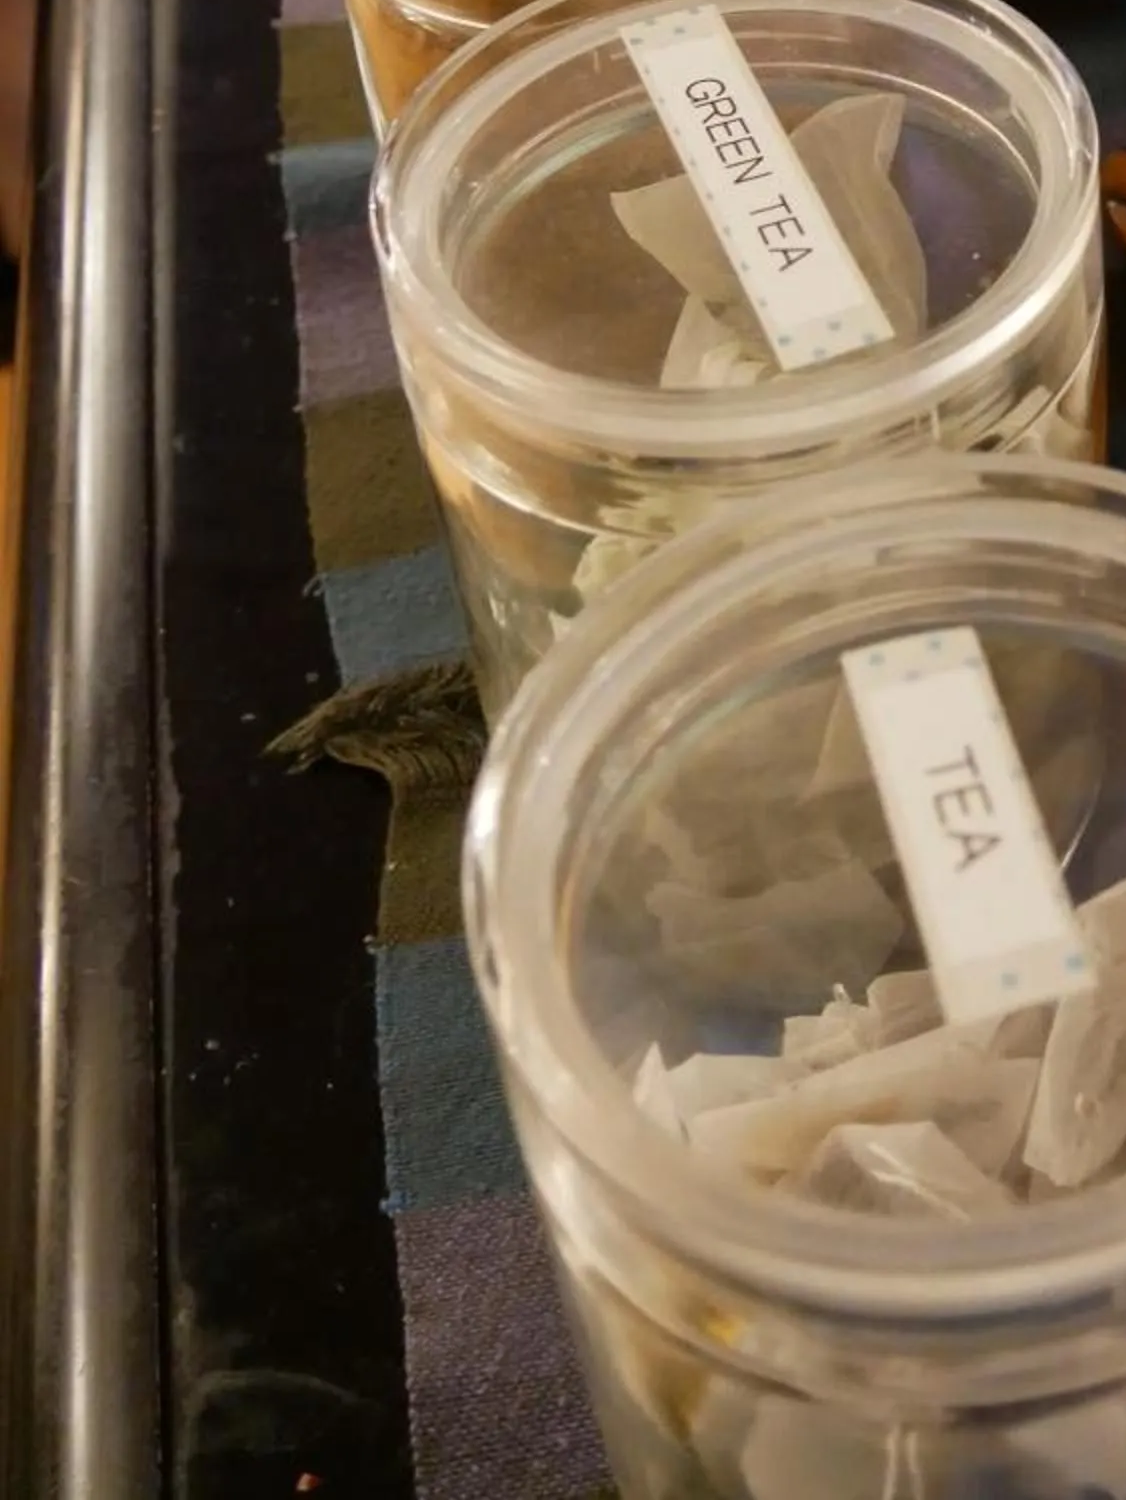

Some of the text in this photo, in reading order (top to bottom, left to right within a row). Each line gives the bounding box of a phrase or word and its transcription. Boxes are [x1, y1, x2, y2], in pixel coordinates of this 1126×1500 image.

[685, 77, 813, 272] GREEN TEA
[925, 744, 1004, 874] TEA
